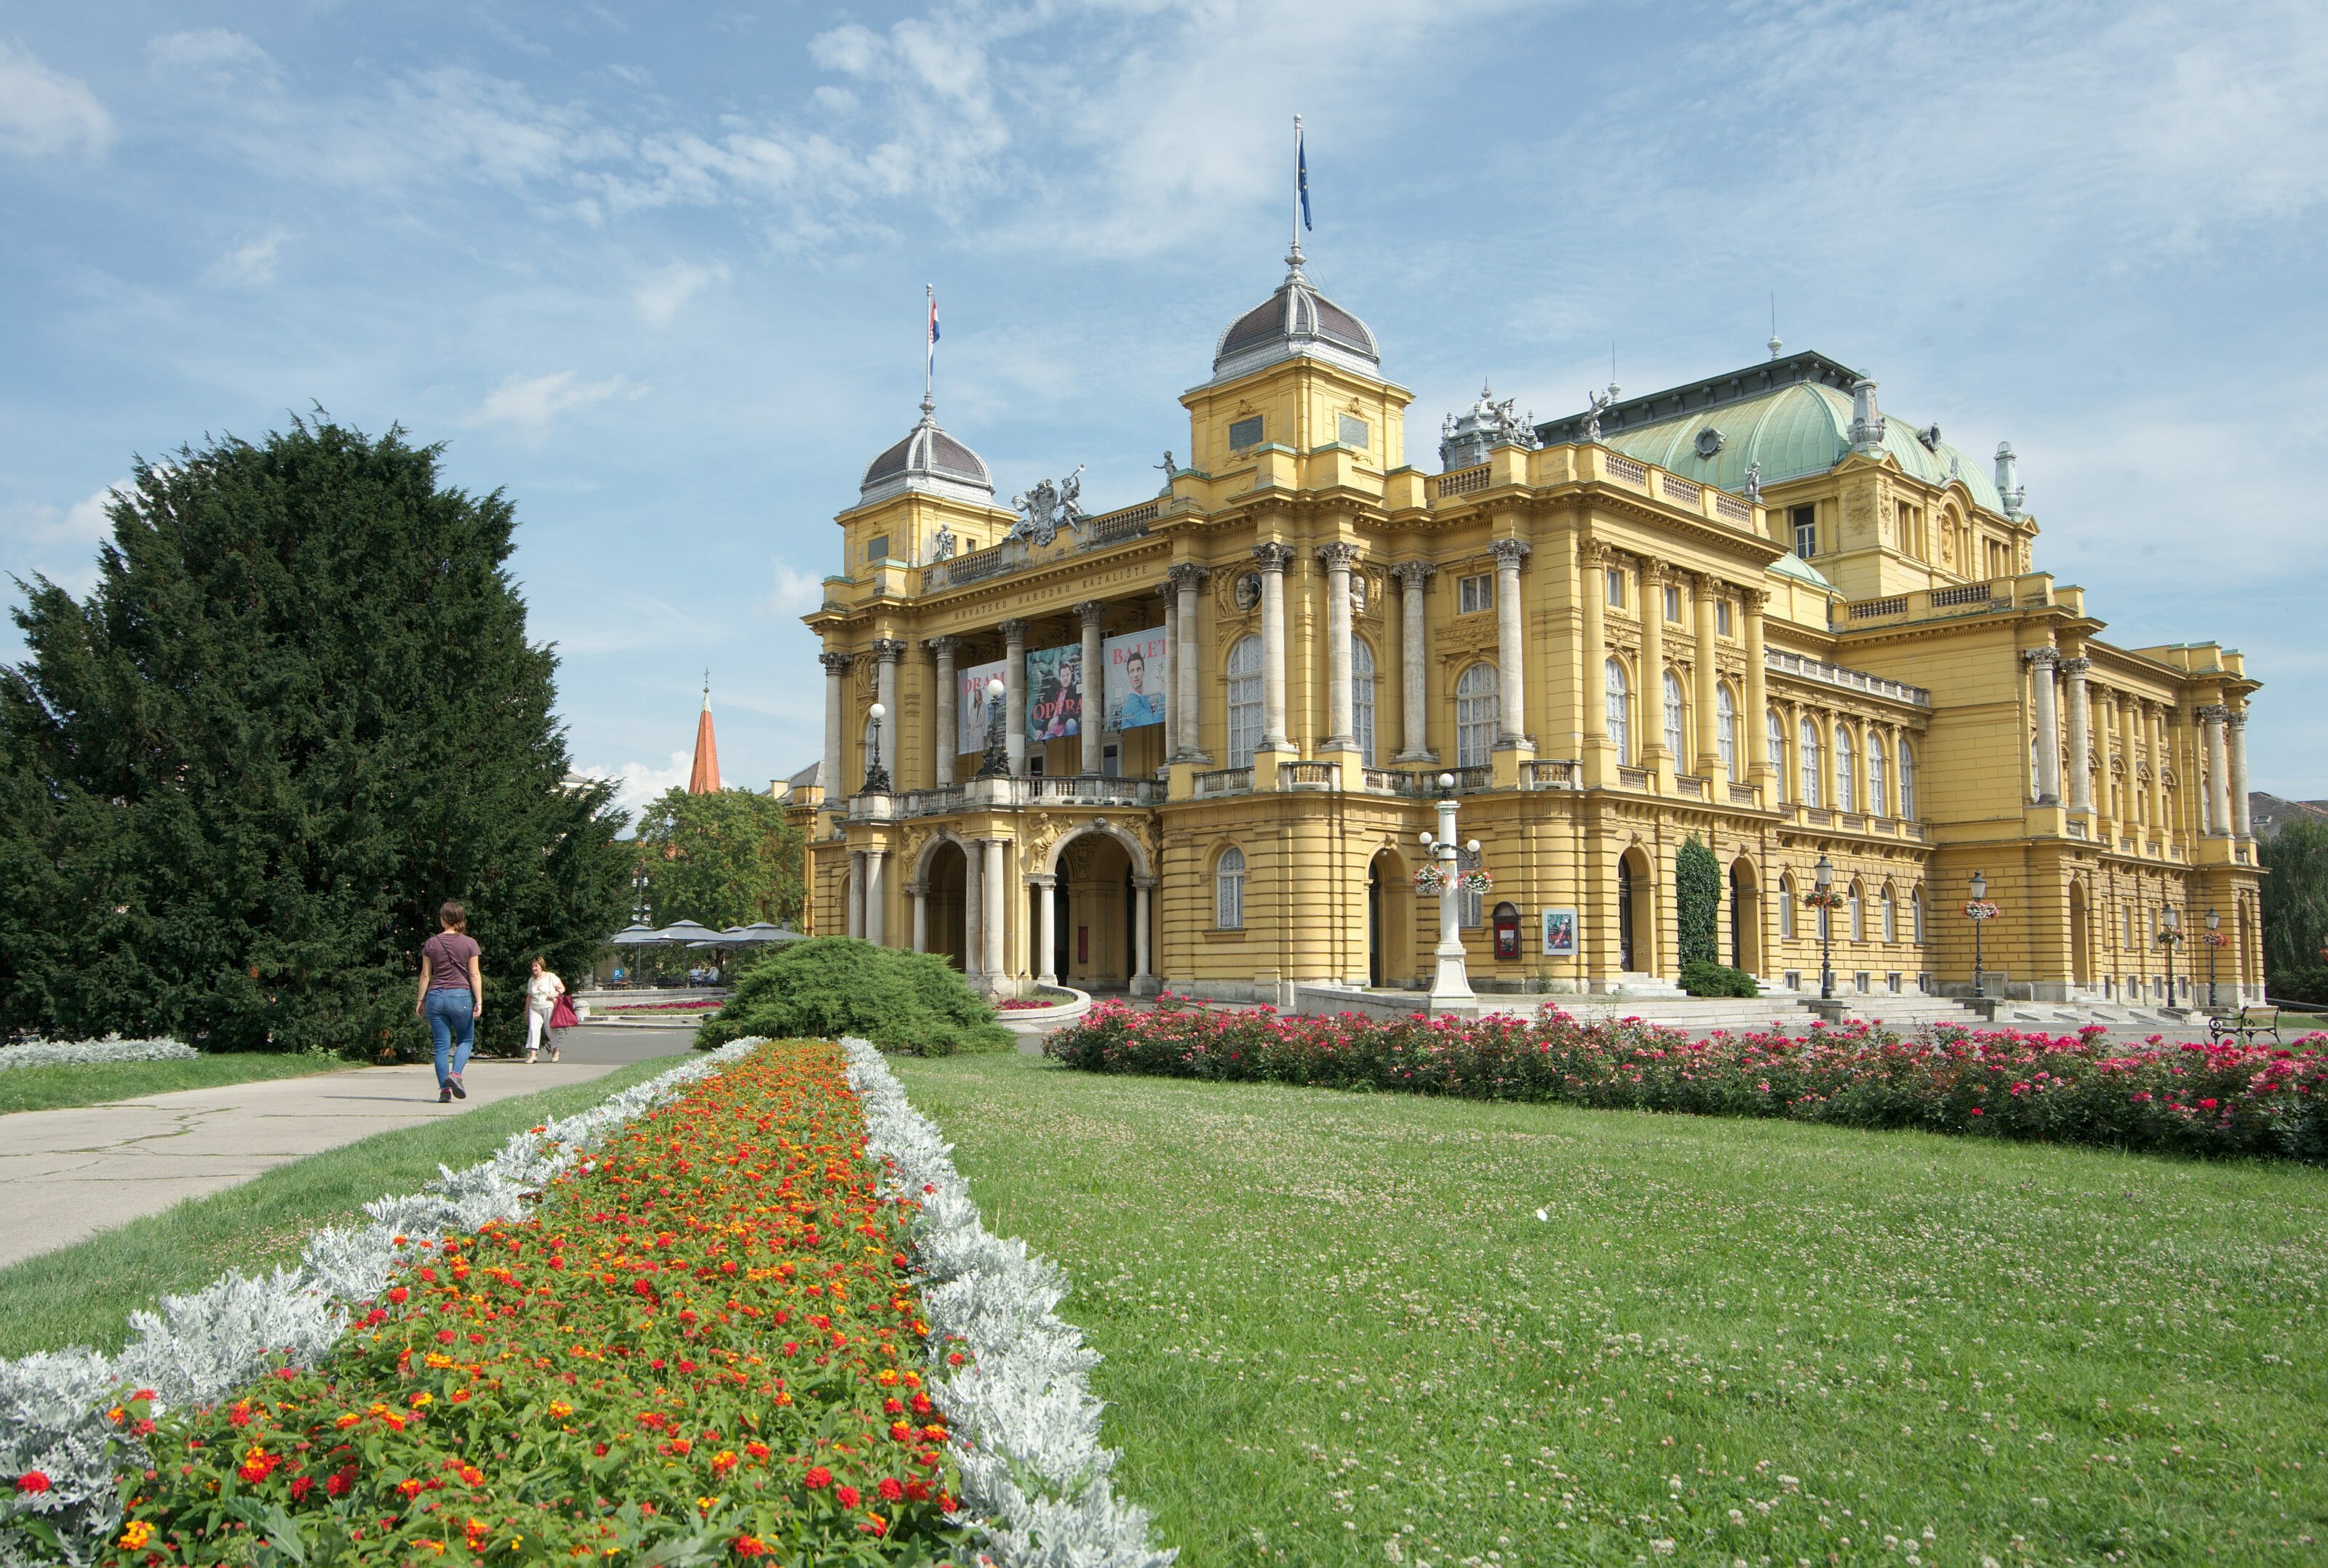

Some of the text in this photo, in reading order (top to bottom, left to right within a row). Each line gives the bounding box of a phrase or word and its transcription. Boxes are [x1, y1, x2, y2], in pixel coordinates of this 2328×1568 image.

[954, 565, 1147, 620] HRVATSKO NARODNO KAZALIŠTE
[962, 671, 1005, 695] DRAM
[1033, 698, 1083, 720] OPERA
